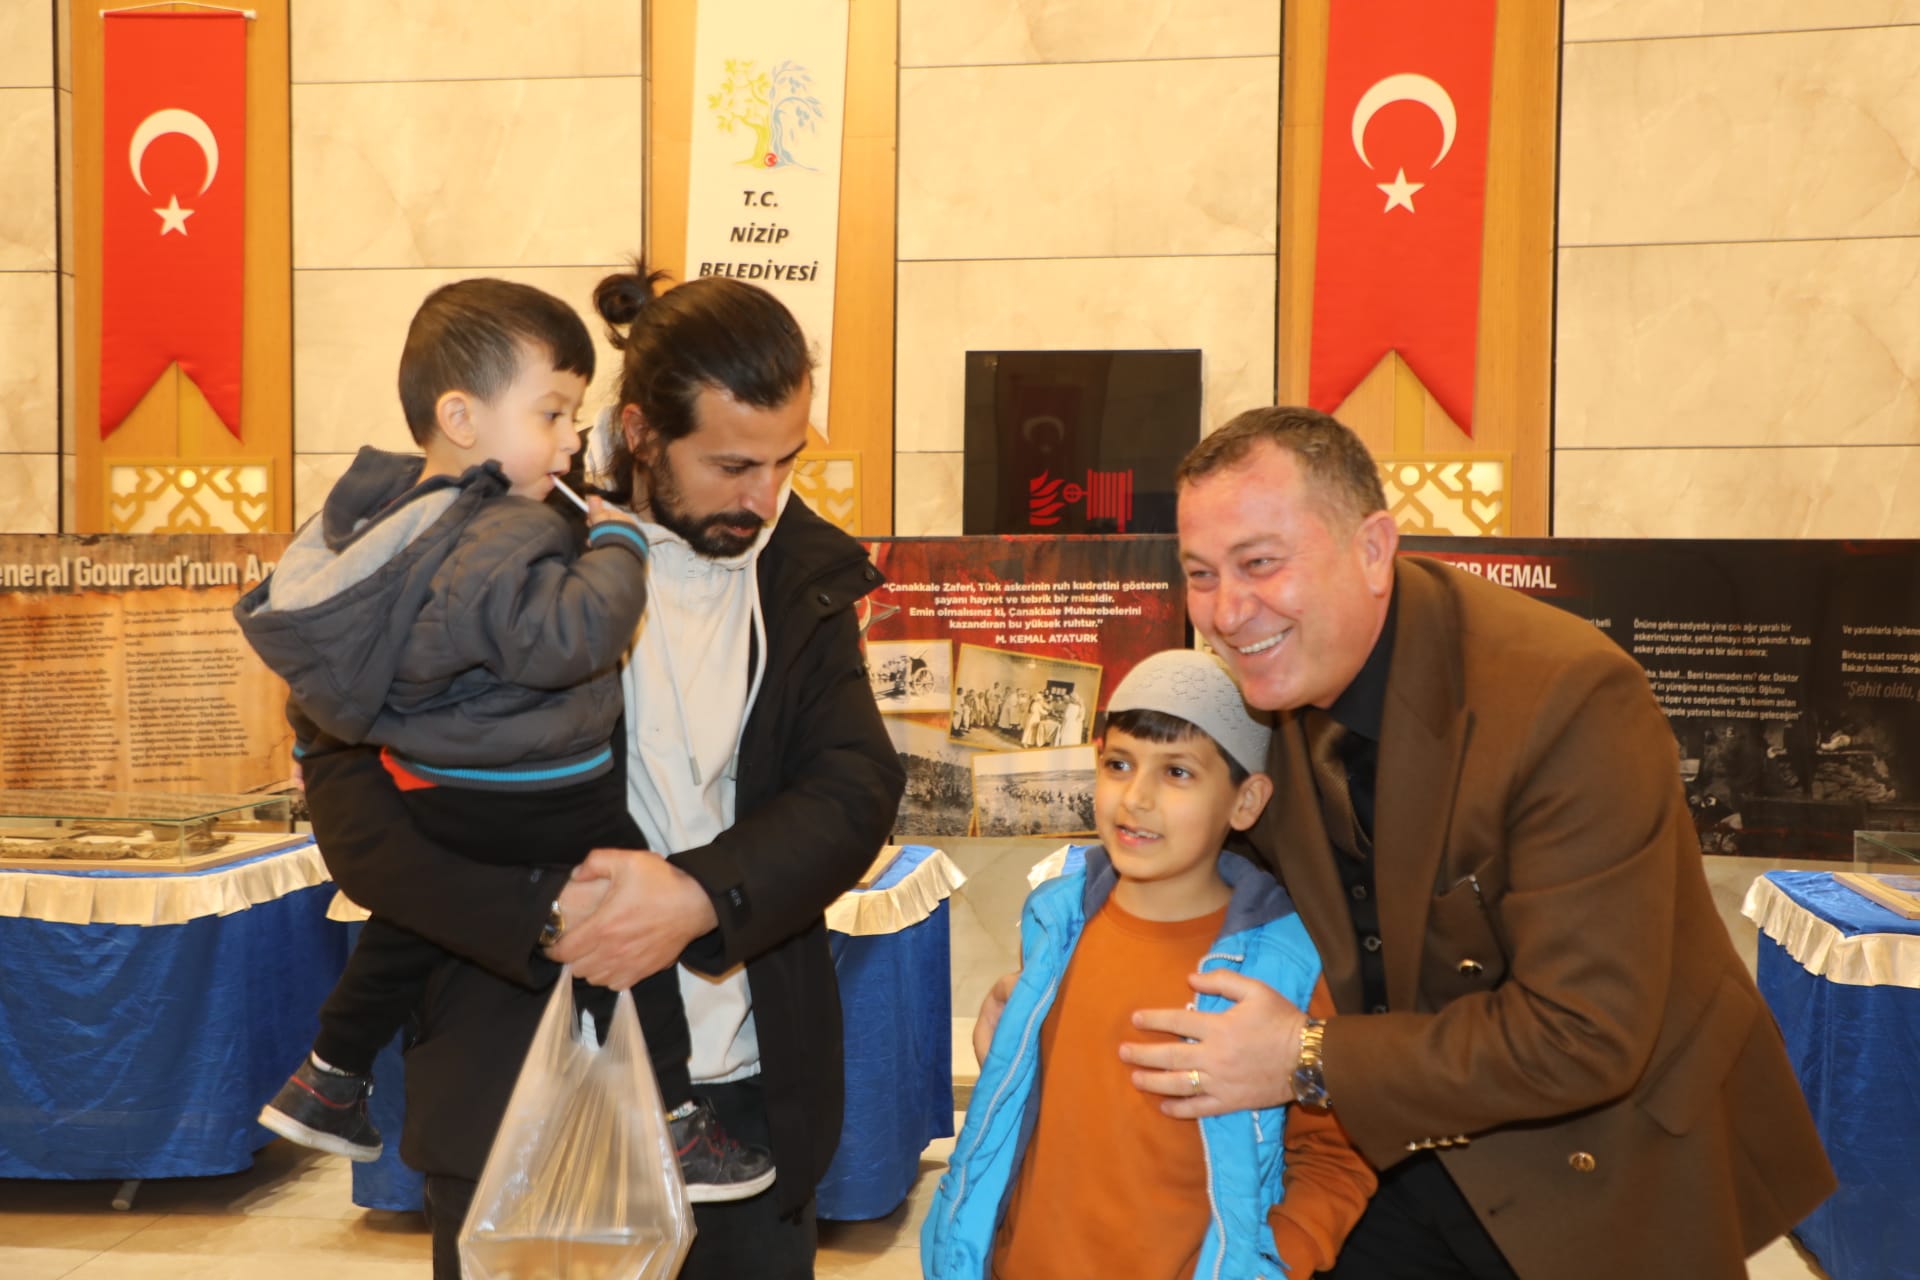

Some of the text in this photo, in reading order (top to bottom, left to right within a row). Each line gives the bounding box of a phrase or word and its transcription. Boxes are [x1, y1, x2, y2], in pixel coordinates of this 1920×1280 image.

[743, 190, 778, 207] T.C.
[729, 222, 790, 244] NİZİP
[698, 259, 819, 281] BELEDİYESİ
[0, 556, 69, 587] neral
[75, 555, 237, 587] Gouraud'nun
[1486, 562, 1557, 589] KEMAL
[943, 583, 976, 593] Zaferi,
[979, 583, 1001, 592] Türk
[1004, 583, 1050, 592] askerinin
[1053, 582, 1070, 590] ruh
[1073, 581, 1120, 591] kudretini
[1122, 581, 1169, 592] gösteren
[970, 596, 1003, 606] hayret
[1021, 595, 1051, 604] tebrik
[1054, 595, 1068, 603] bir
[910, 607, 935, 616] Emin
[1009, 607, 1062, 618] Çanakkale
[1064, 606, 1142, 616] Muharebelerini
[949, 620, 1006, 629] kazandıran
[1008, 620, 1022, 629] bu
[1025, 619, 1061, 630] yüksek
[1658, 620, 1679, 631] gelen
[995, 634, 1007, 644] M.
[1009, 634, 1046, 644] KEMAL
[1705, 647, 1715, 656] ve
